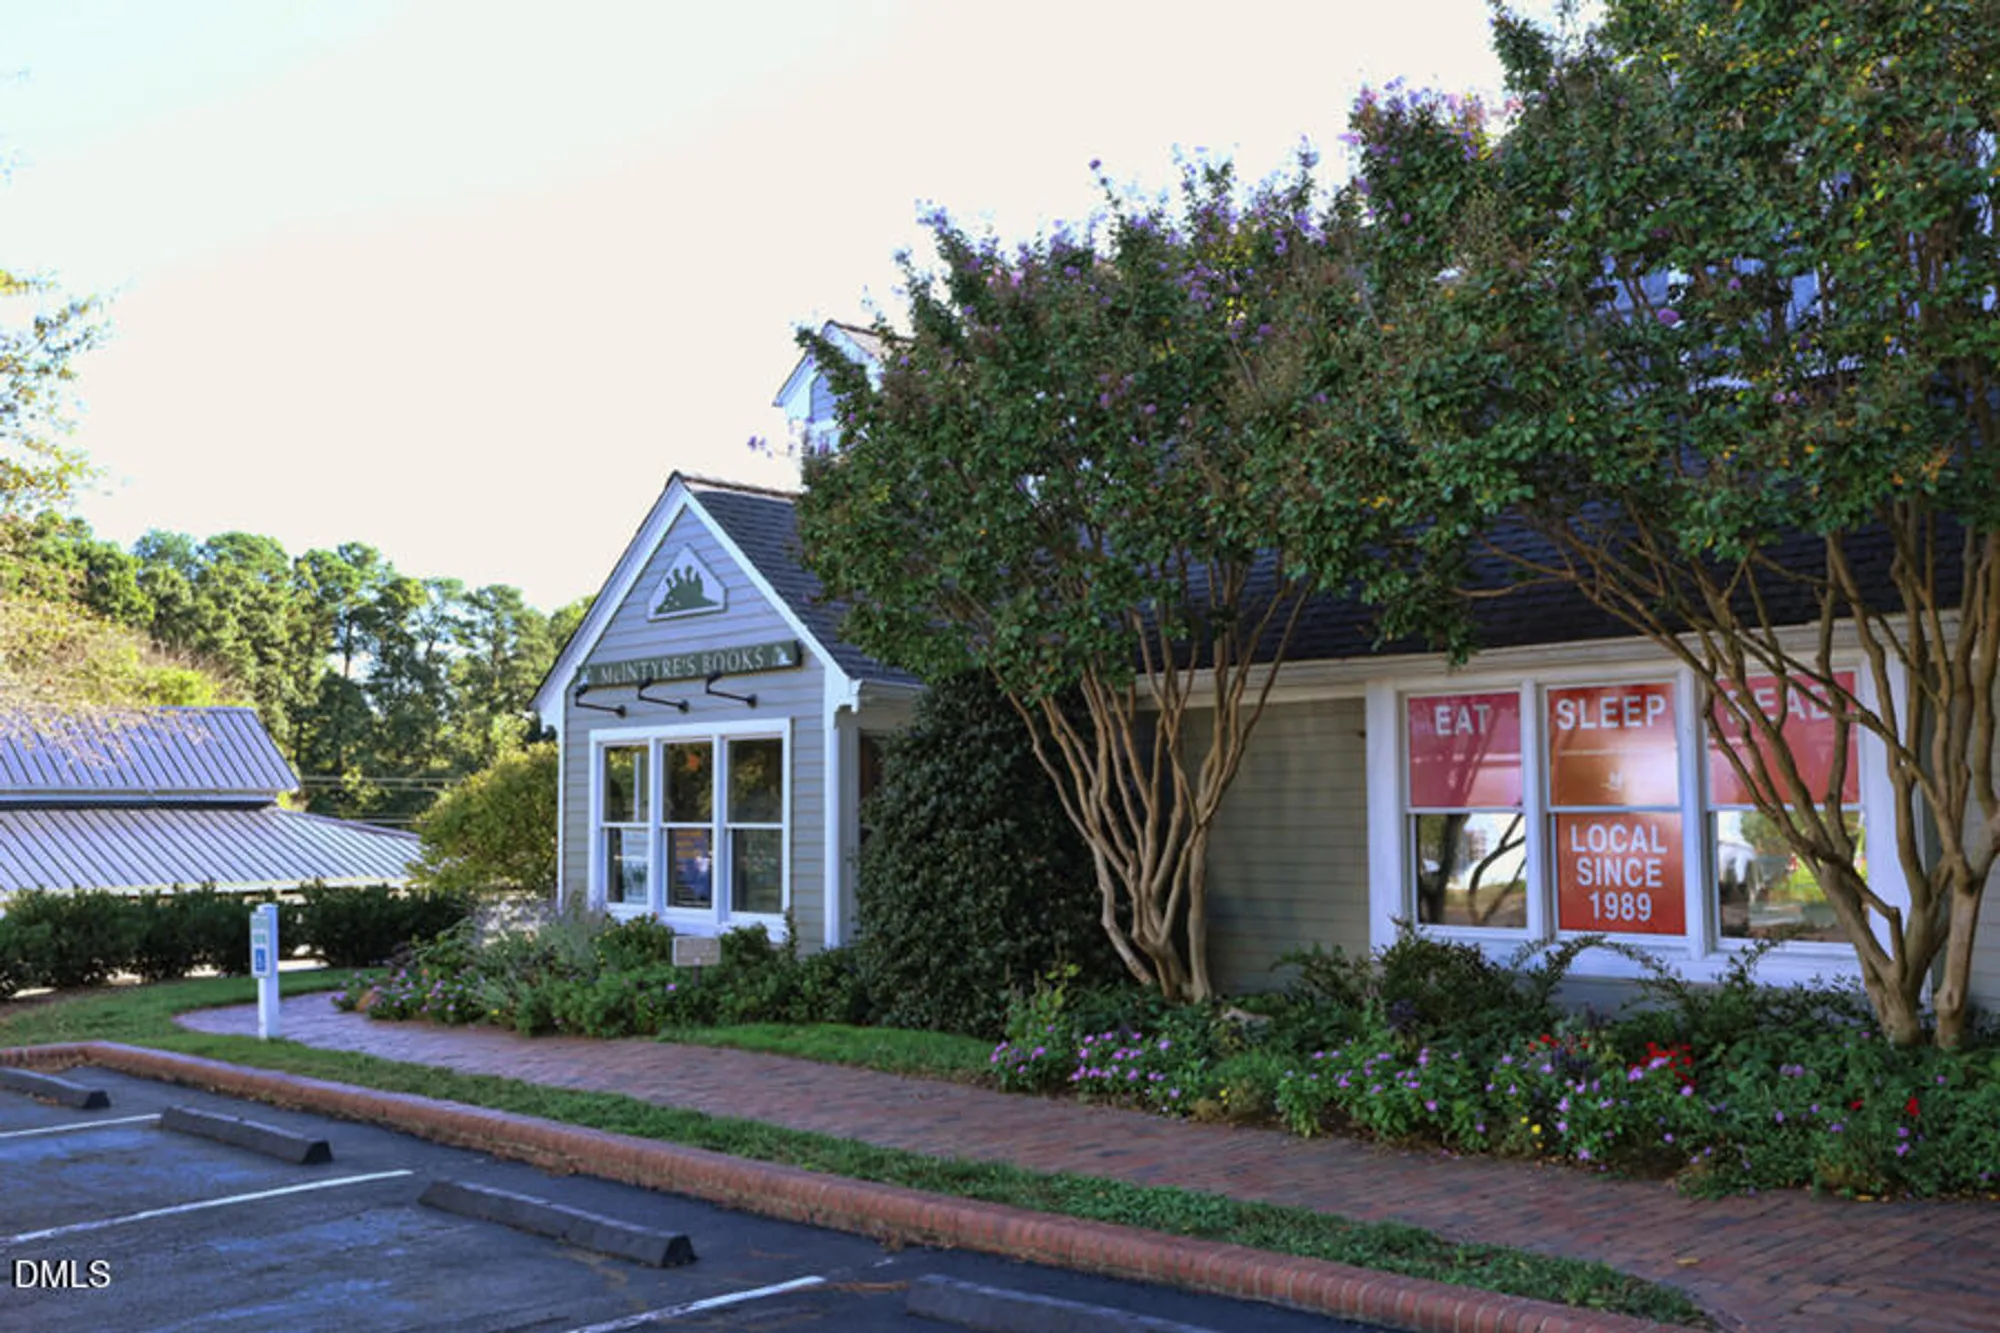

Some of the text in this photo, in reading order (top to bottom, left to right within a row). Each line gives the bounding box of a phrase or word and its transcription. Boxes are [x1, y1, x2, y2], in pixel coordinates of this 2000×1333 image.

[702, 646, 764, 675] BOOKS
[1434, 705, 1489, 736] EAT
[1556, 695, 1666, 731] SLEEP
[1571, 824, 1668, 854] LOCAL
[1576, 856, 1664, 888] SINCE
[1588, 891, 1652, 922] 1989
